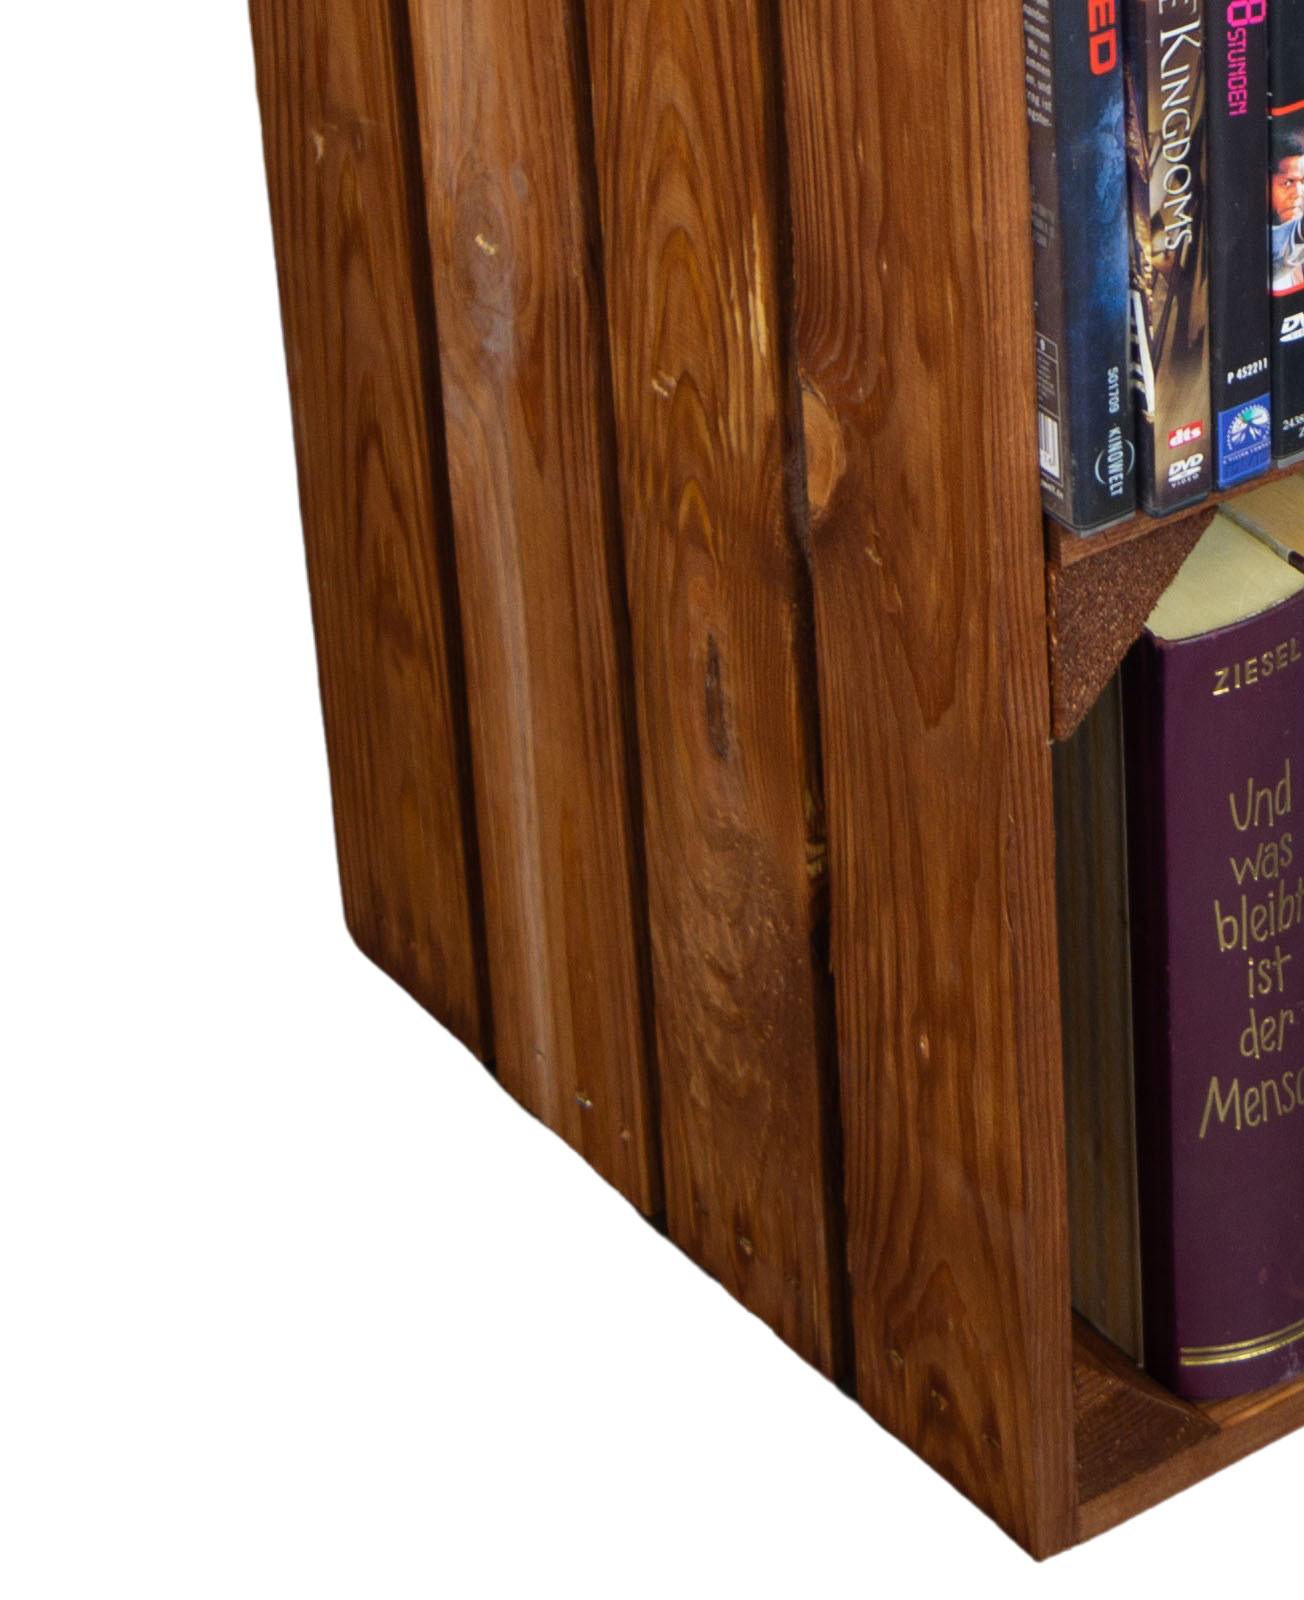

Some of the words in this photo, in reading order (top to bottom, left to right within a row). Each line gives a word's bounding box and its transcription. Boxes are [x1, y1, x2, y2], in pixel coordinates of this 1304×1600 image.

[1227, 27, 1249, 117] STUNDEN
[1160, 18, 1201, 250] KINGDOMS
[1107, 426, 1124, 497] KINOWELT
[1168, 453, 1204, 477] DVD
[1169, 426, 1202, 448] dts
[1212, 637, 1302, 696] ZIESEL
[1229, 758, 1291, 831] Und
[1229, 832, 1293, 885] was
[1248, 945, 1292, 998] ist
[1239, 1008, 1294, 1060] der
